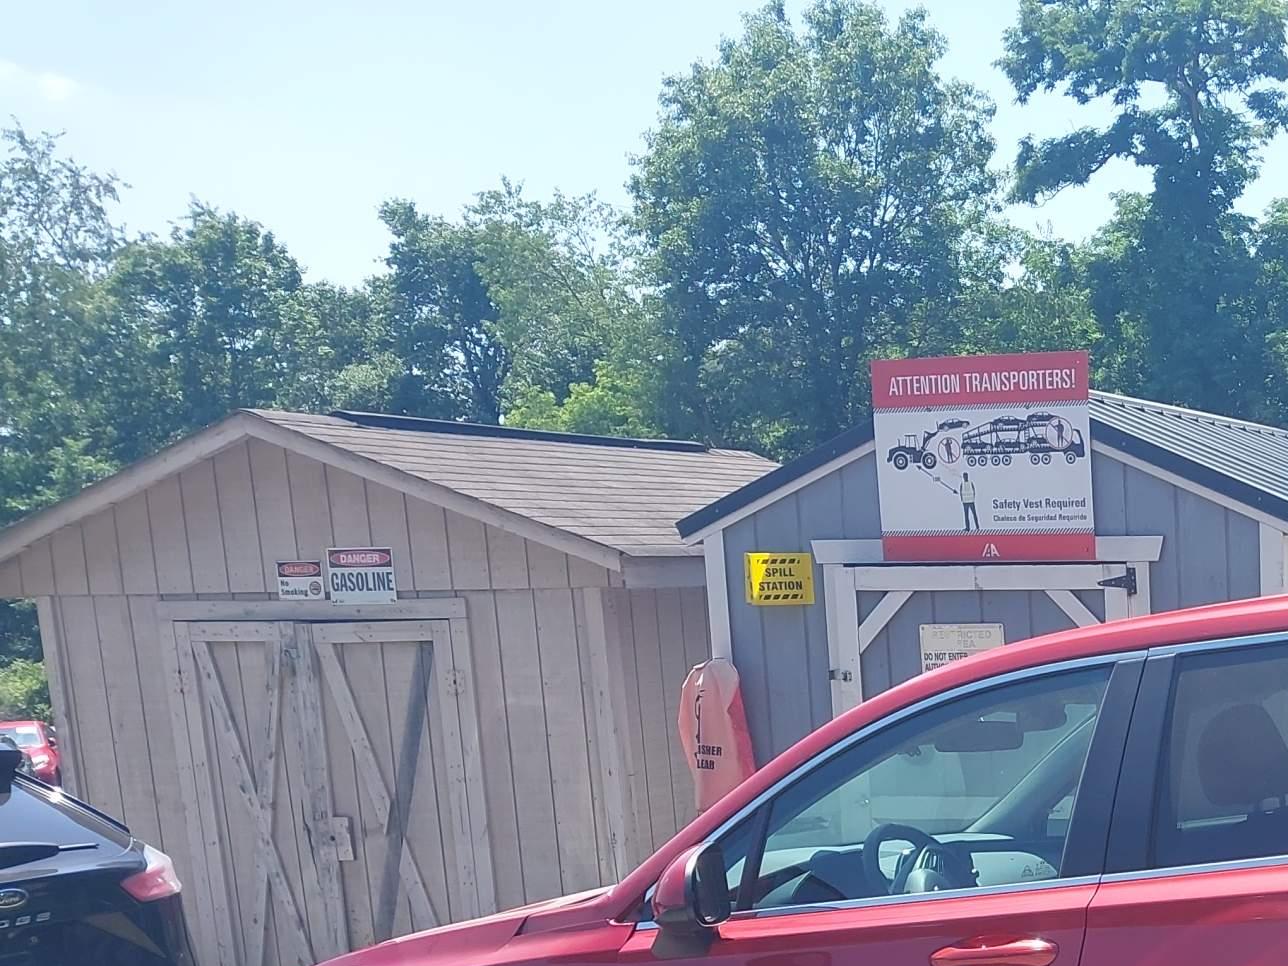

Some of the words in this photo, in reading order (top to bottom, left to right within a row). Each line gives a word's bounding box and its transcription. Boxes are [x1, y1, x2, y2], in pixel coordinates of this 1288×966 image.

[889, 374, 960, 396] ATTENTION
[963, 369, 1076, 393] TRANSPORTERS!
[992, 499, 1021, 511] Safety
[1023, 498, 1042, 508] Vest
[1045, 497, 1086, 510] Required
[1027, 514, 1057, 522] Seguridad
[340, 554, 379, 563] DANGER
[765, 568, 795, 577] SPILL
[331, 572, 394, 592] GASOLINE
[758, 580, 802, 591] STATION
[924, 652, 934, 661] DO
[934, 652, 947, 661] NOT
